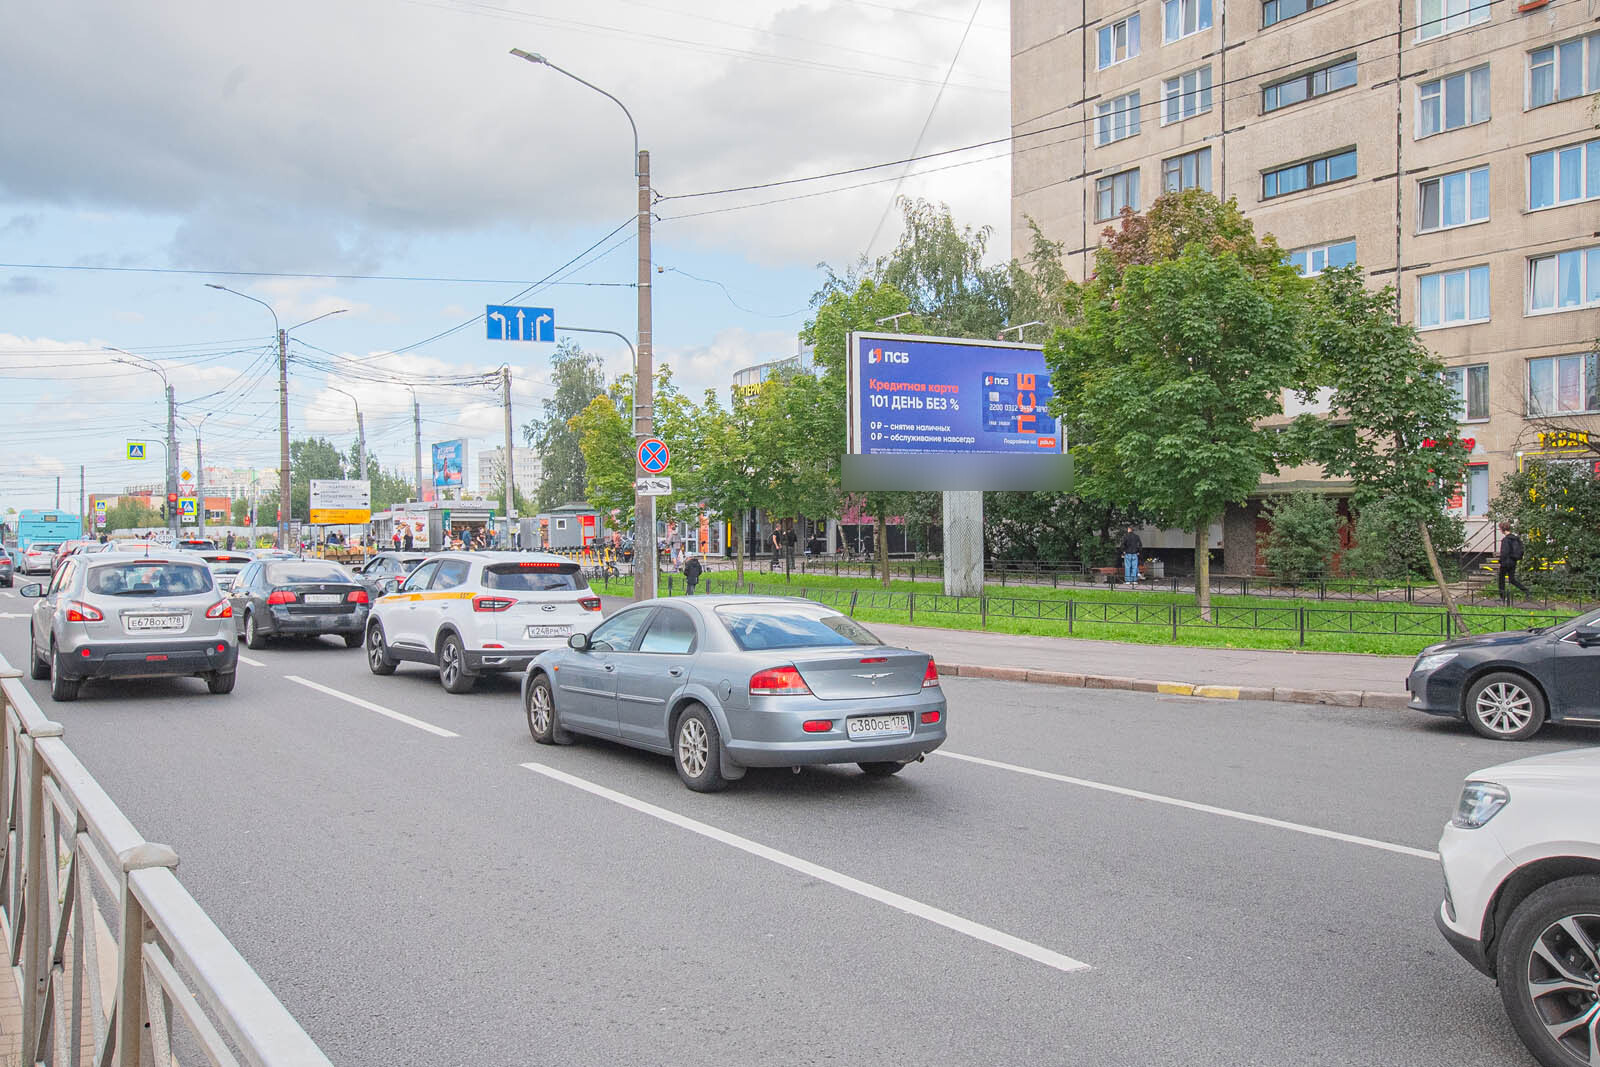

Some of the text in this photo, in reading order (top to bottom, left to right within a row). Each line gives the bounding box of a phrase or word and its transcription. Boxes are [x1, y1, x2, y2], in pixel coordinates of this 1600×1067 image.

[885, 351, 909, 363] ПСБ
[869, 379, 958, 395] Кредитная карта
[994, 377, 1009, 385] ПСБ
[870, 395, 959, 410] 101 ДЕНЬ БЕЗ %
[1017, 373, 1036, 433] ПСБ
[890, 423, 915, 431] снятие
[890, 433, 941, 443] обслуживание
